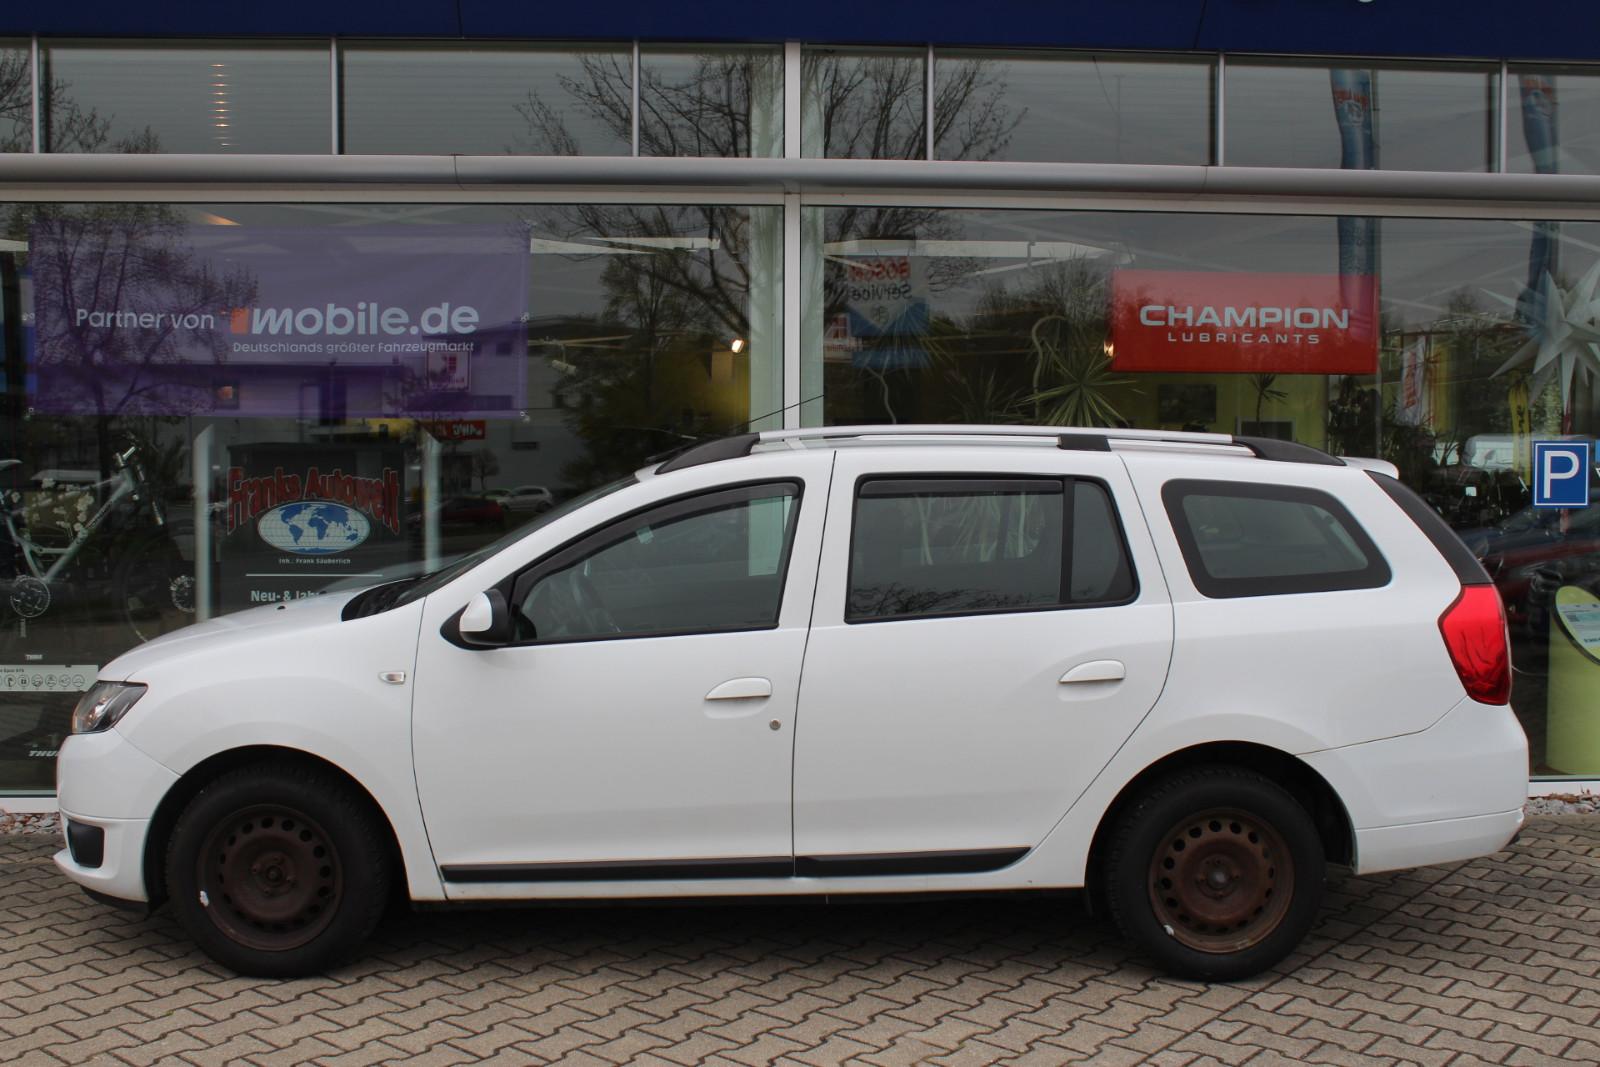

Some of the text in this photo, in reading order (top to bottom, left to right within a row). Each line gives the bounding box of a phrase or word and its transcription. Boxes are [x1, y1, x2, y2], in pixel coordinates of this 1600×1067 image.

[76, 308, 215, 330] Partner von
[251, 302, 480, 335] mobile.de
[1140, 304, 1348, 328] CHAMPION
[232, 341, 475, 355] Deutschlands größter Fahrzeugmarkt
[1167, 332, 1320, 344] LUBRICANTS
[1543, 450, 1580, 499] P
[227, 466, 400, 536] Franks Autowelt
[250, 590, 281, 602] Neu-
[283, 590, 292, 602] &
